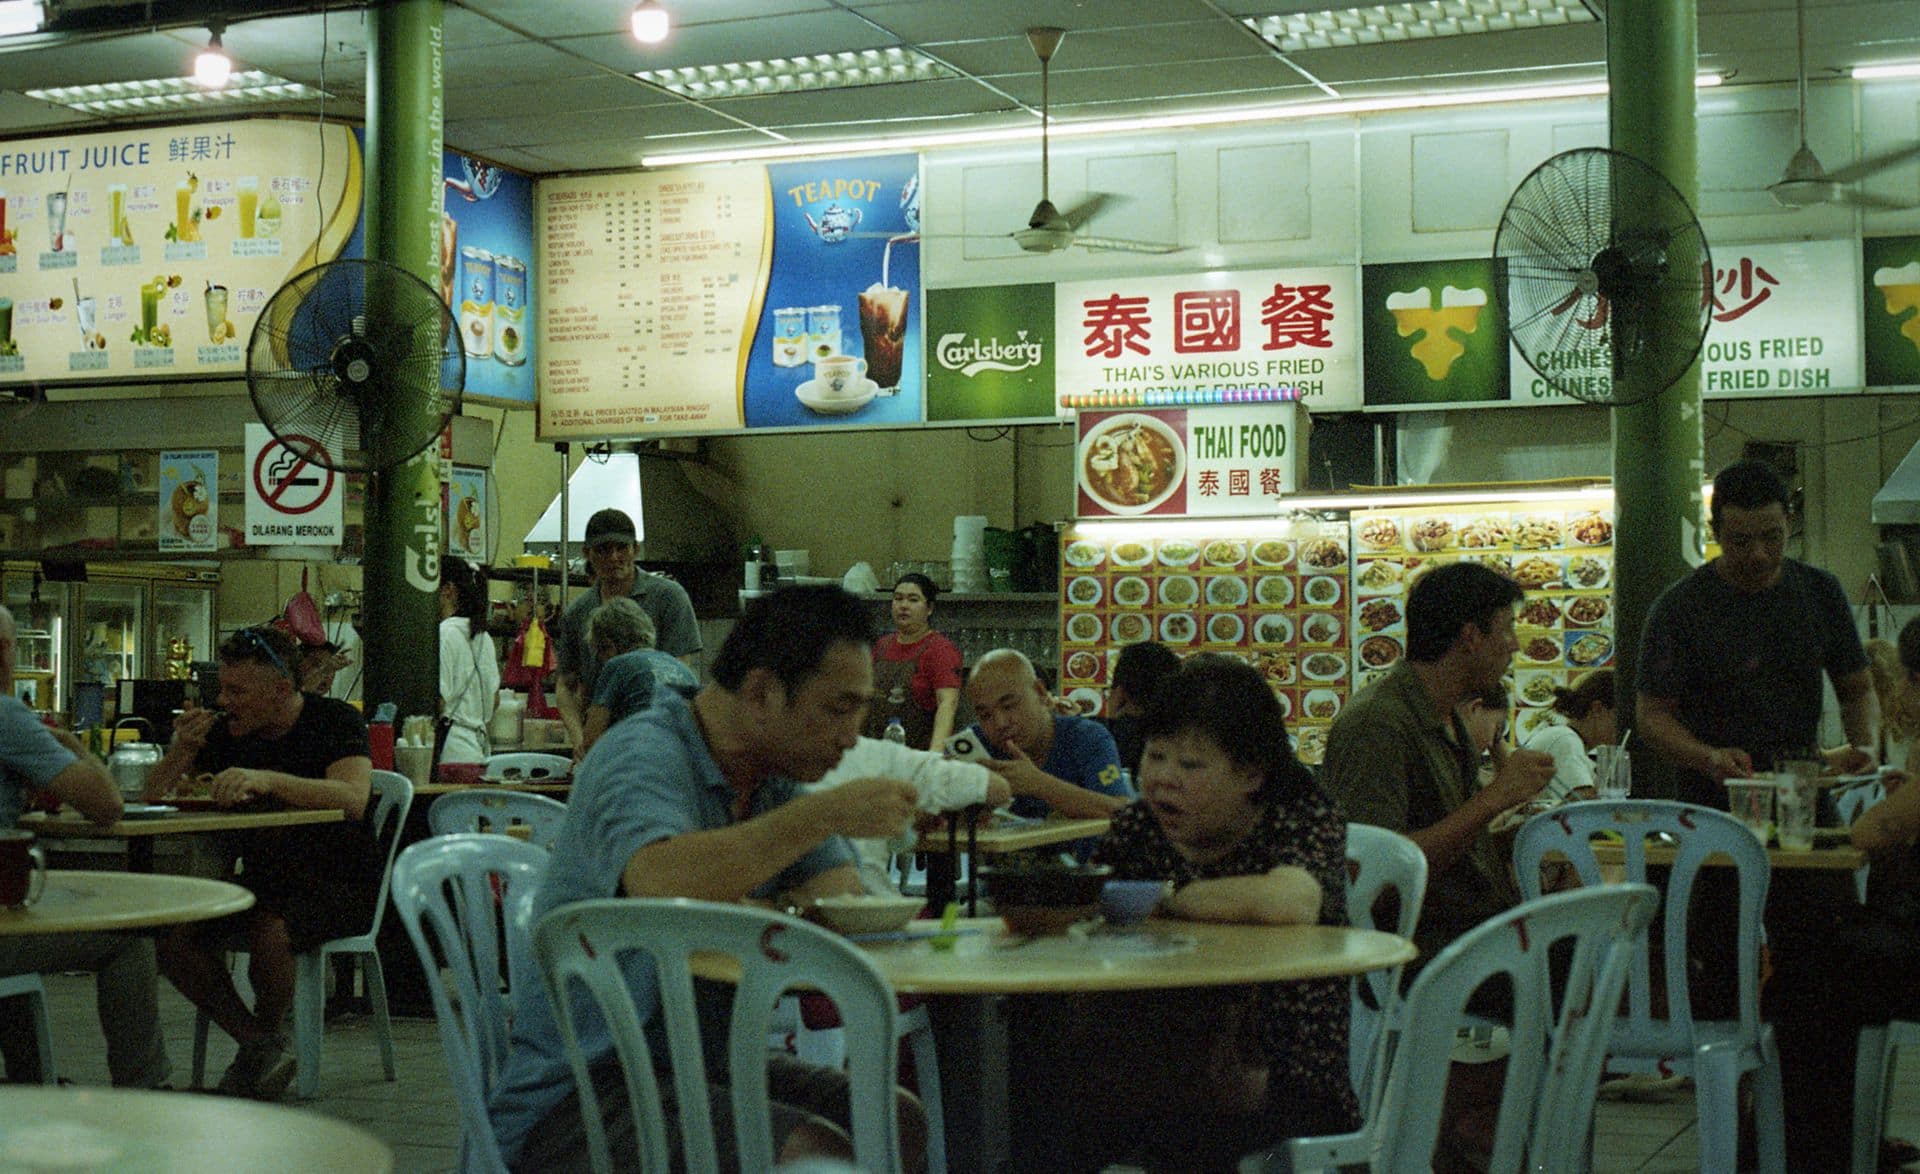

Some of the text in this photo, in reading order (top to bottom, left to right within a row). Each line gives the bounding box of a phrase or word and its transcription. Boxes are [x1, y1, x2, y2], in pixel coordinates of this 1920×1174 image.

[429, 23, 442, 89] world.
[428, 95, 442, 130] the
[1, 142, 150, 177] FRUIT JUICE
[168, 132, 236, 162] 鲜果汁
[428, 138, 442, 159] in
[428, 165, 442, 213] beer
[788, 178, 881, 209] TEAPOT
[427, 219, 441, 267] best
[1082, 282, 1335, 359] 泰國餐
[936, 332, 1043, 371] Carlsberg
[1760, 337, 1824, 359] FRIED
[1102, 358, 1325, 382] THAI'S VARIOUS FRIED
[1707, 369, 1770, 390] FRIED
[1778, 368, 1830, 388] DISH
[1193, 424, 1287, 460] THAI FOOD
[1198, 467, 1282, 497] 泰國餐
[252, 524, 335, 537] DILARANG MEROKOK
